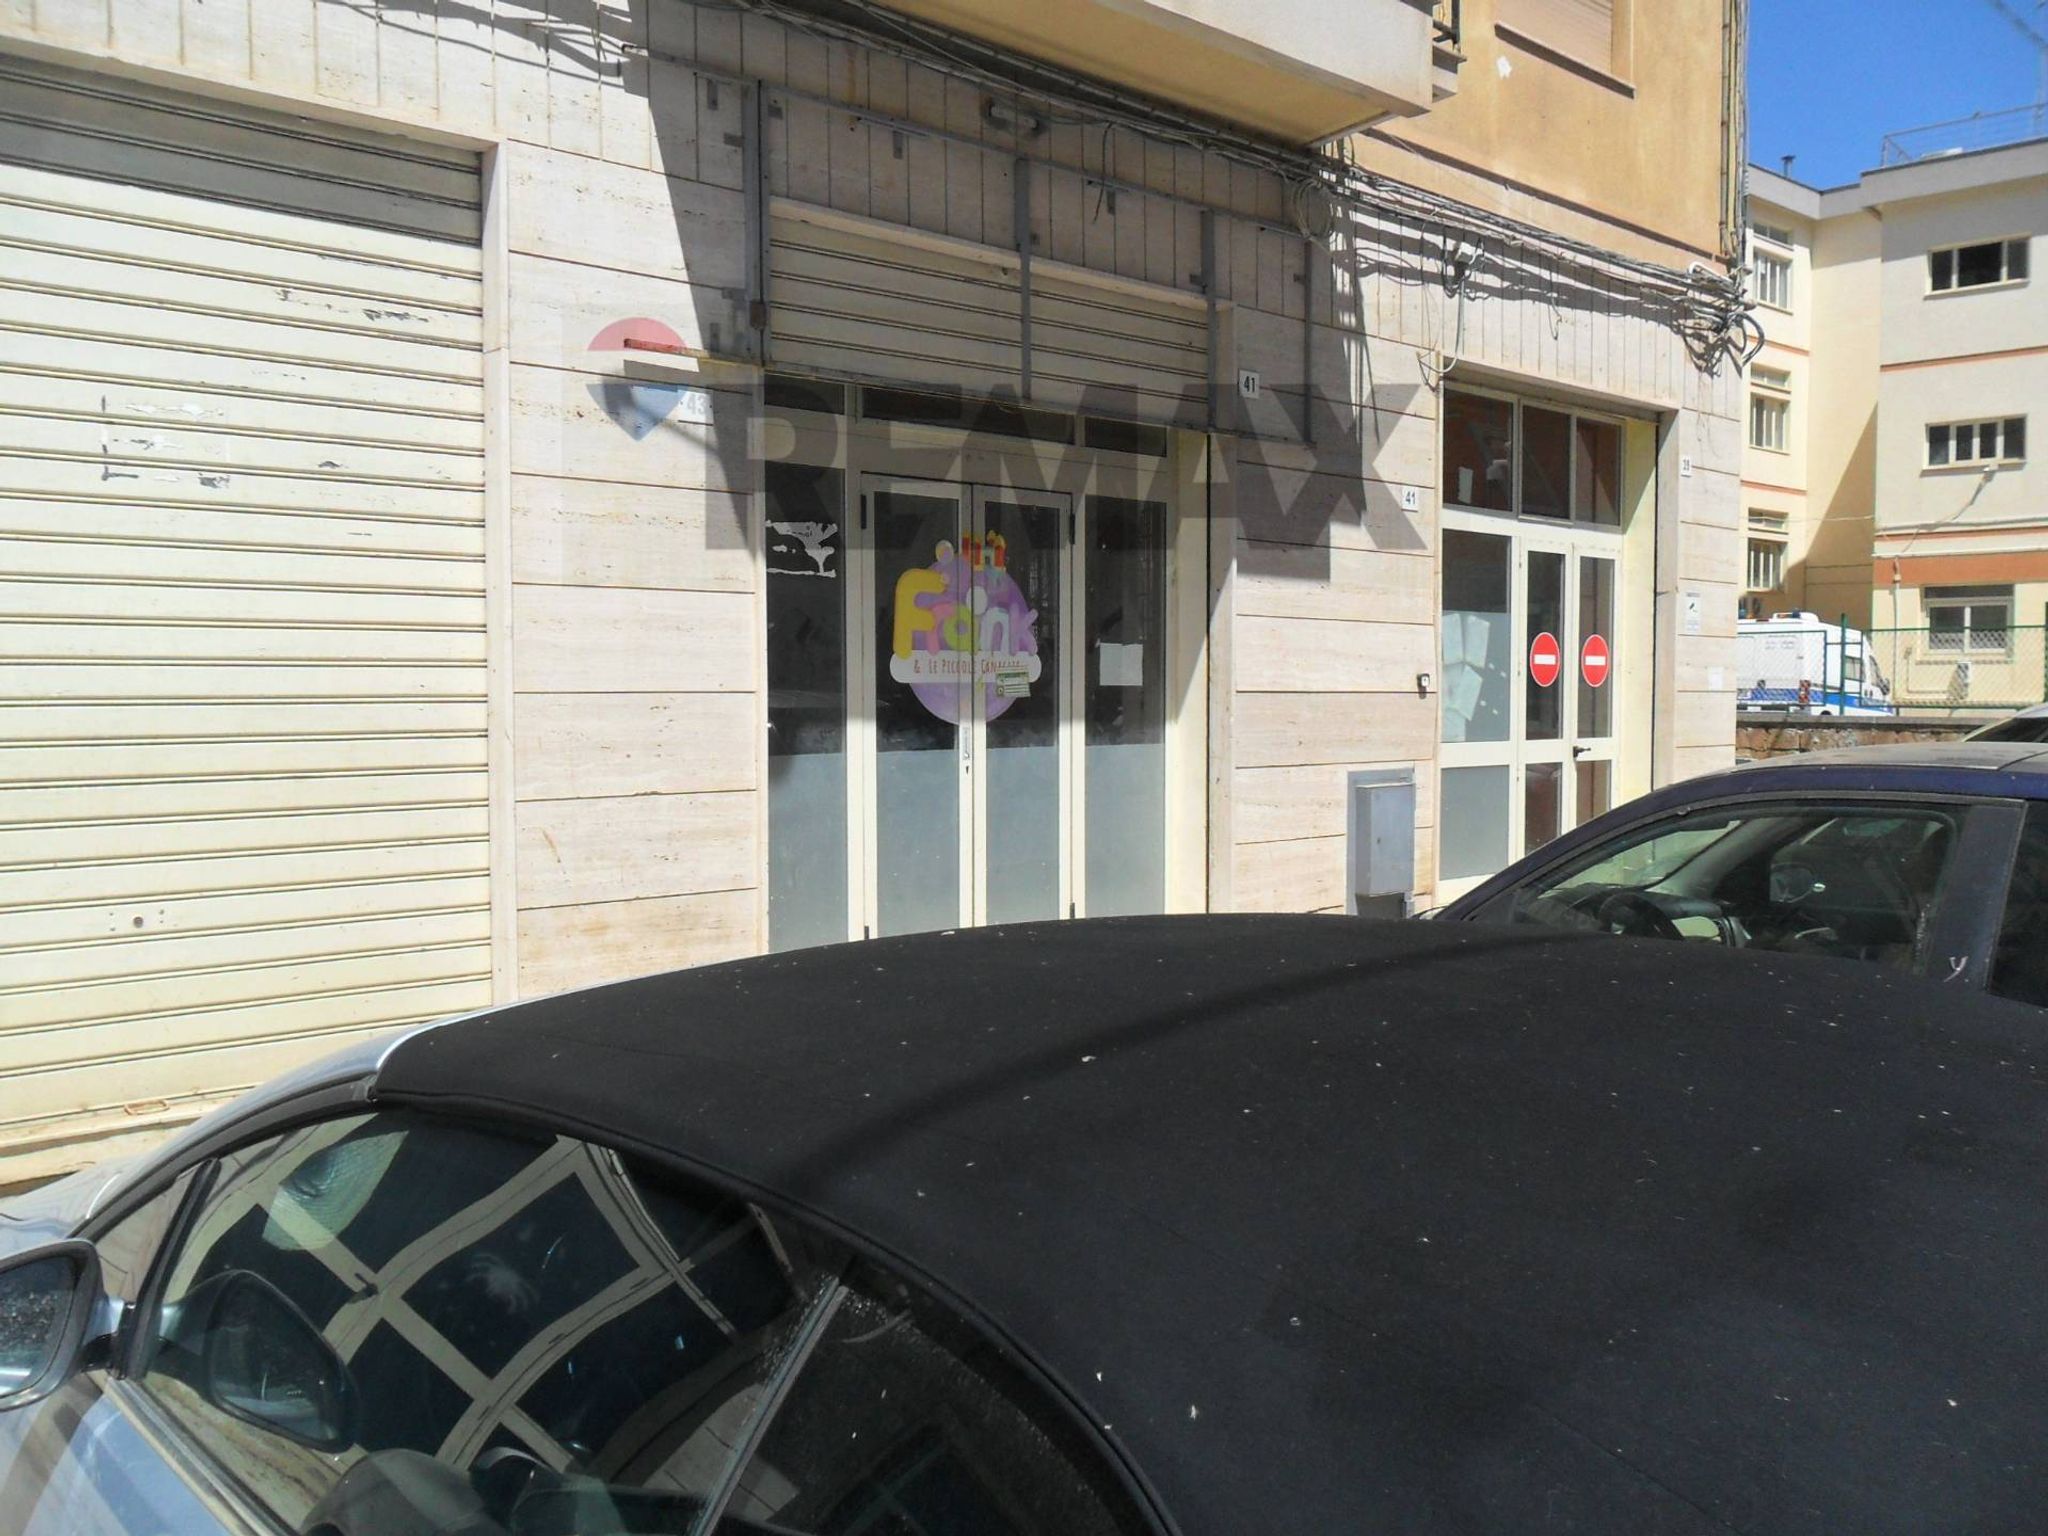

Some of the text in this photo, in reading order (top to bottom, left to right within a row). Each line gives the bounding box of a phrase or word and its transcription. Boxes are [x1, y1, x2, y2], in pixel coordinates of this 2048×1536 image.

[1243, 375, 1256, 393] 41
[687, 393, 708, 415] 43
[1405, 490, 1416, 505] 41
